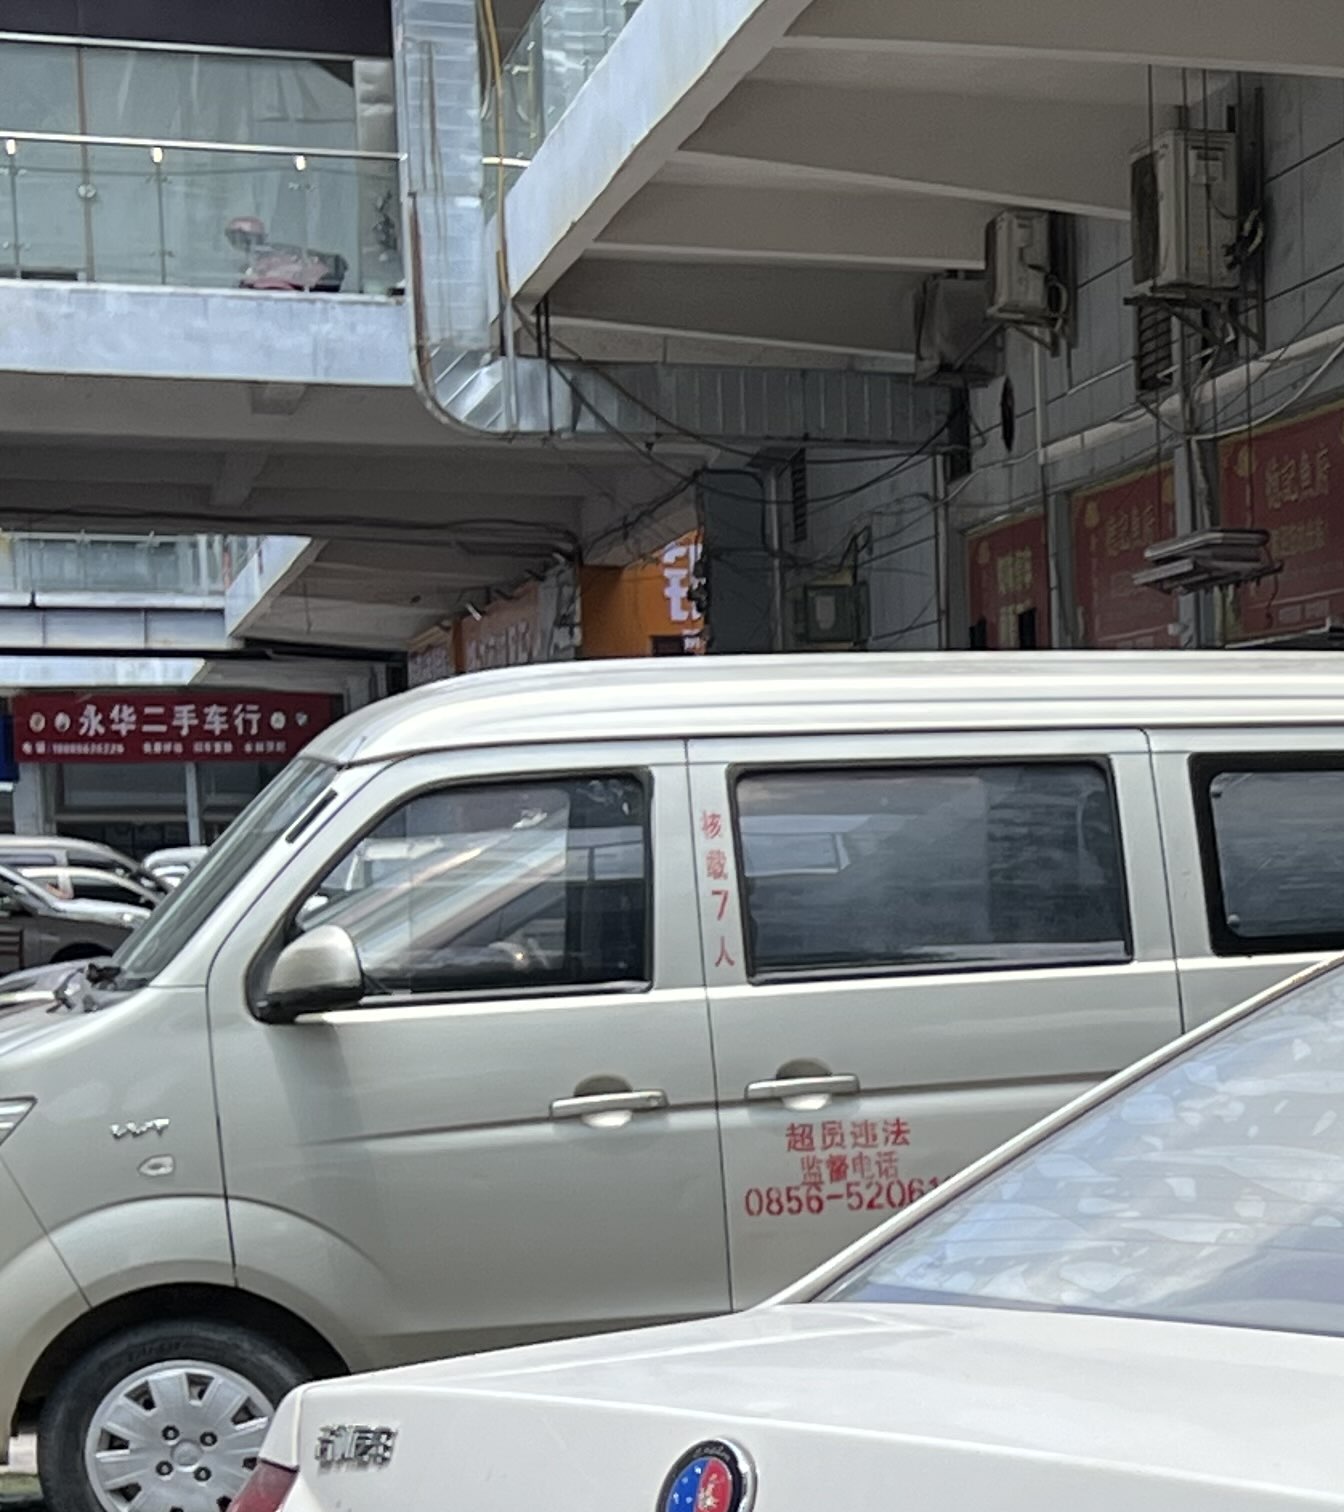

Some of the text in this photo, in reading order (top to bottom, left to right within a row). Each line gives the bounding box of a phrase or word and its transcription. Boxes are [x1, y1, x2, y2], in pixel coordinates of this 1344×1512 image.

[79, 703, 260, 737] 永华二手车行
[702, 809, 736, 968] 核载7人
[786, 1117, 911, 1153] 超员违法
[801, 1151, 898, 1190] 监督电话
